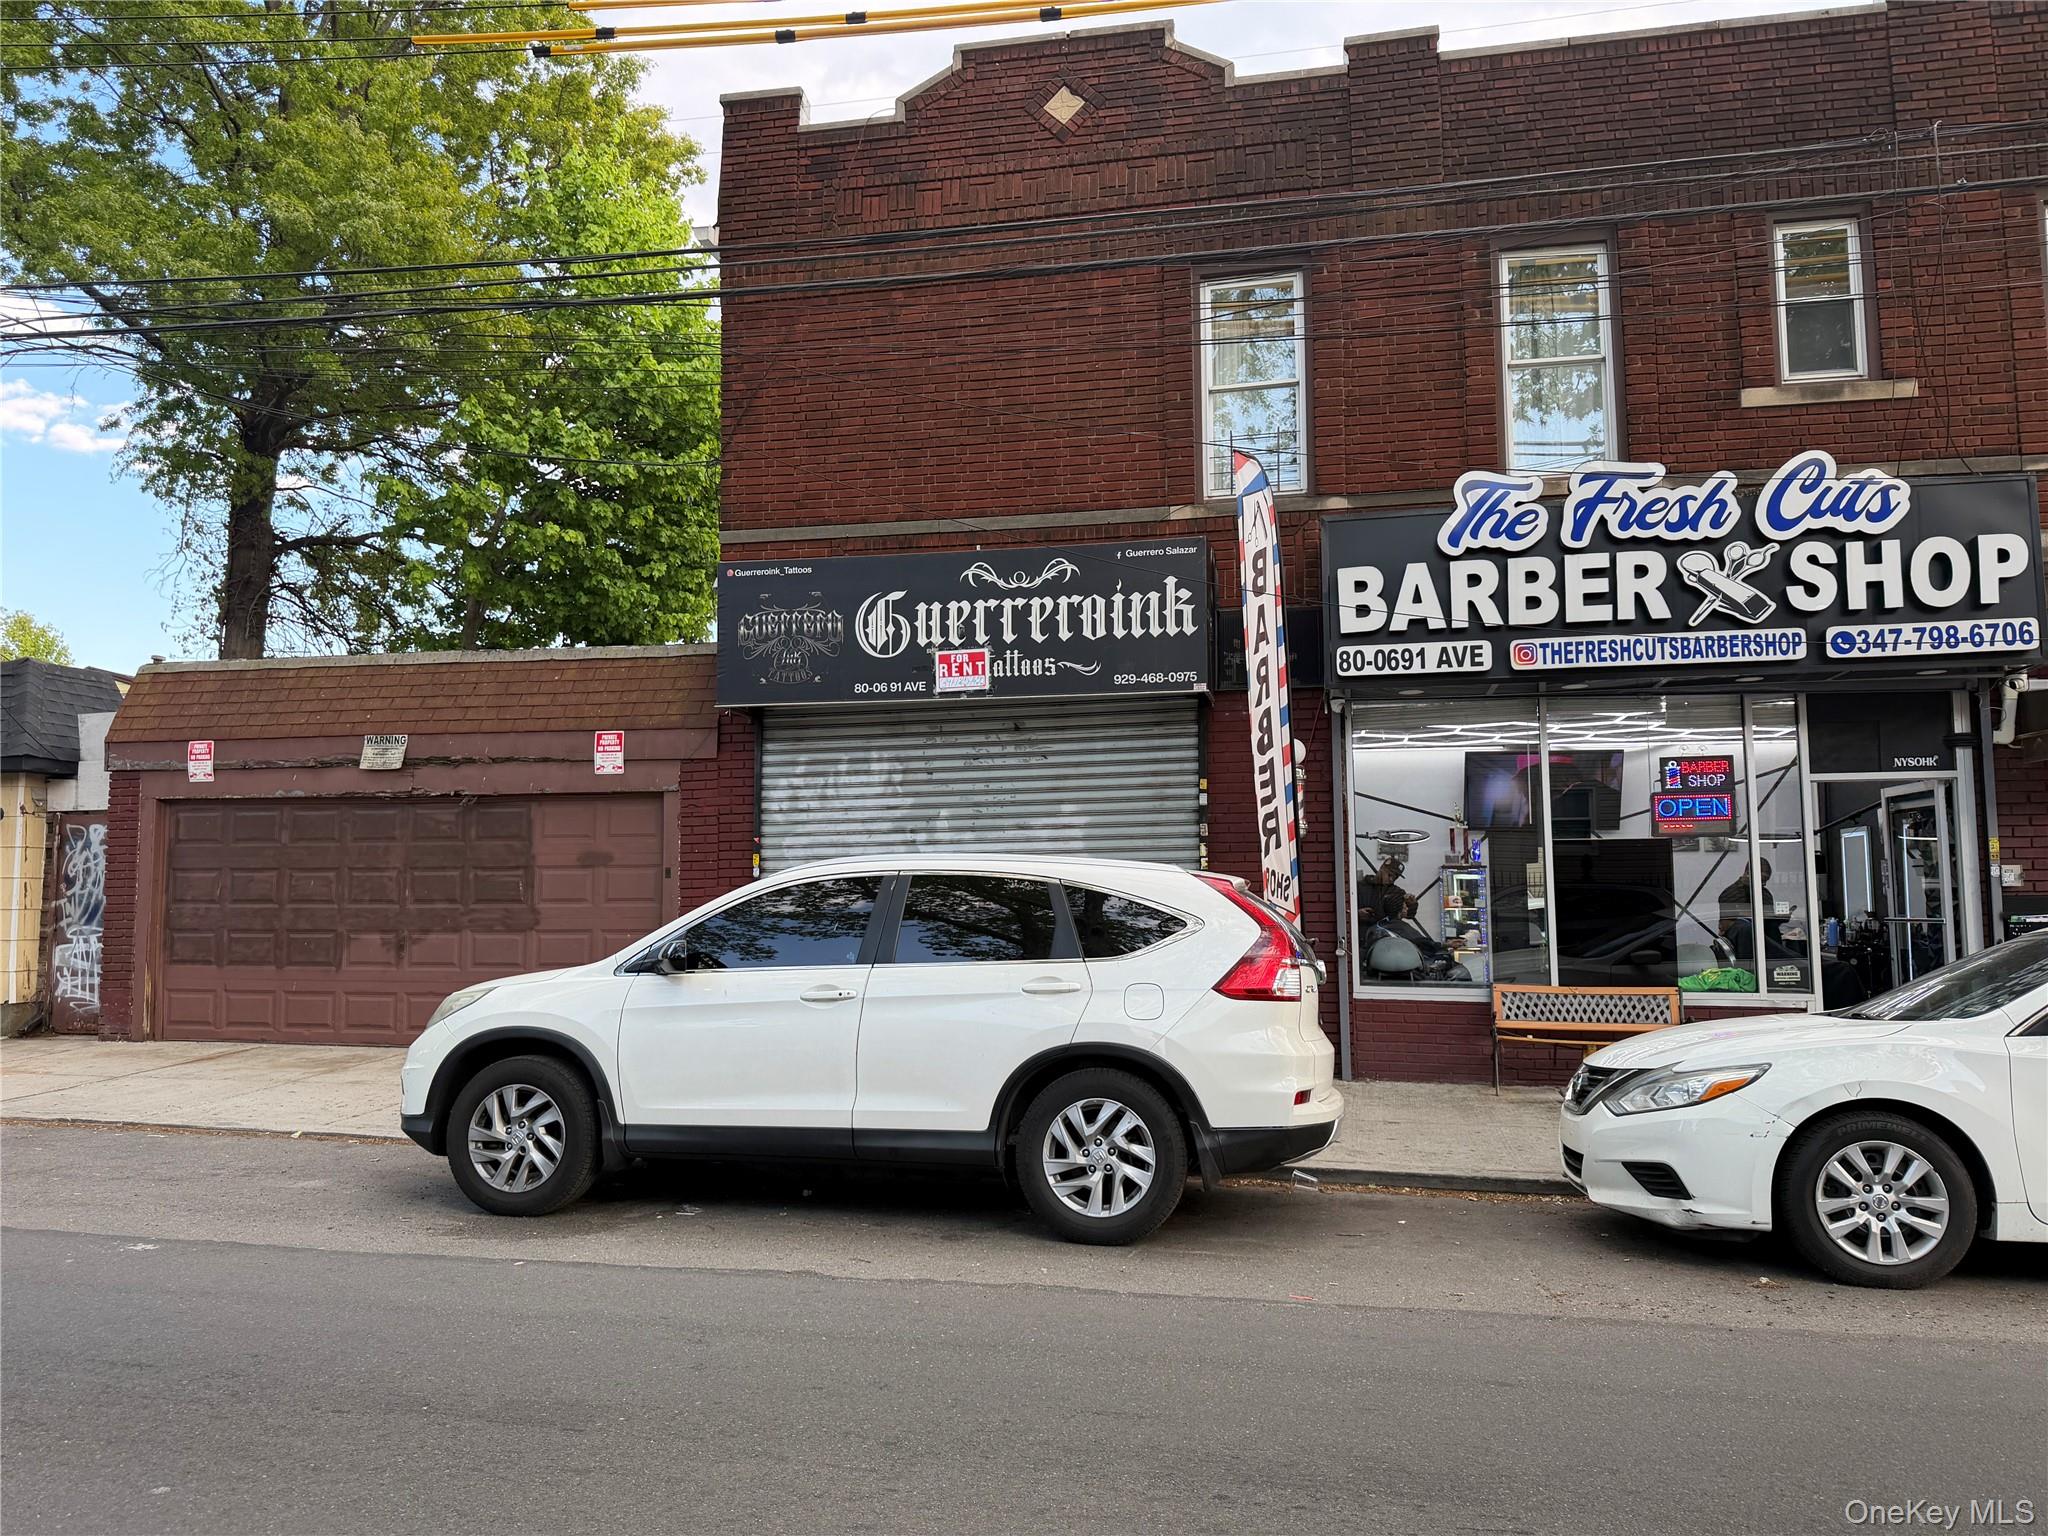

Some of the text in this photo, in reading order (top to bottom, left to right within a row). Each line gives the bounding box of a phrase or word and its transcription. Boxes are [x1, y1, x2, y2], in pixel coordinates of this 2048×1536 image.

[1446, 457, 1902, 549] The Fresh Cuts
[1125, 549, 1165, 558] Guerrero
[1165, 546, 1198, 556] Salazar
[734, 566, 813, 577] Guerreroink_Tattoos
[1336, 532, 2030, 635] BARBER SHOP
[854, 575, 1199, 659] Guerreroink
[1856, 620, 2034, 654] 347-798-6706
[1538, 631, 1802, 665] THEFRESHCUTSBARBERSHOP
[950, 653, 969, 664] FOR
[987, 649, 1057, 678] attoos
[1338, 644, 1484, 673] 80-0691 AVE
[939, 661, 985, 678] RENT
[1113, 671, 1198, 685] 929-468-0975
[854, 682, 888, 694] 80-06
[889, 681, 902, 693] 91
[903, 681, 927, 692] AVE
[366, 735, 407, 745] WARNING
[1680, 760, 1730, 774] BARBER
[1687, 773, 1727, 787] SHOP
[1658, 797, 1729, 817] OPEN
